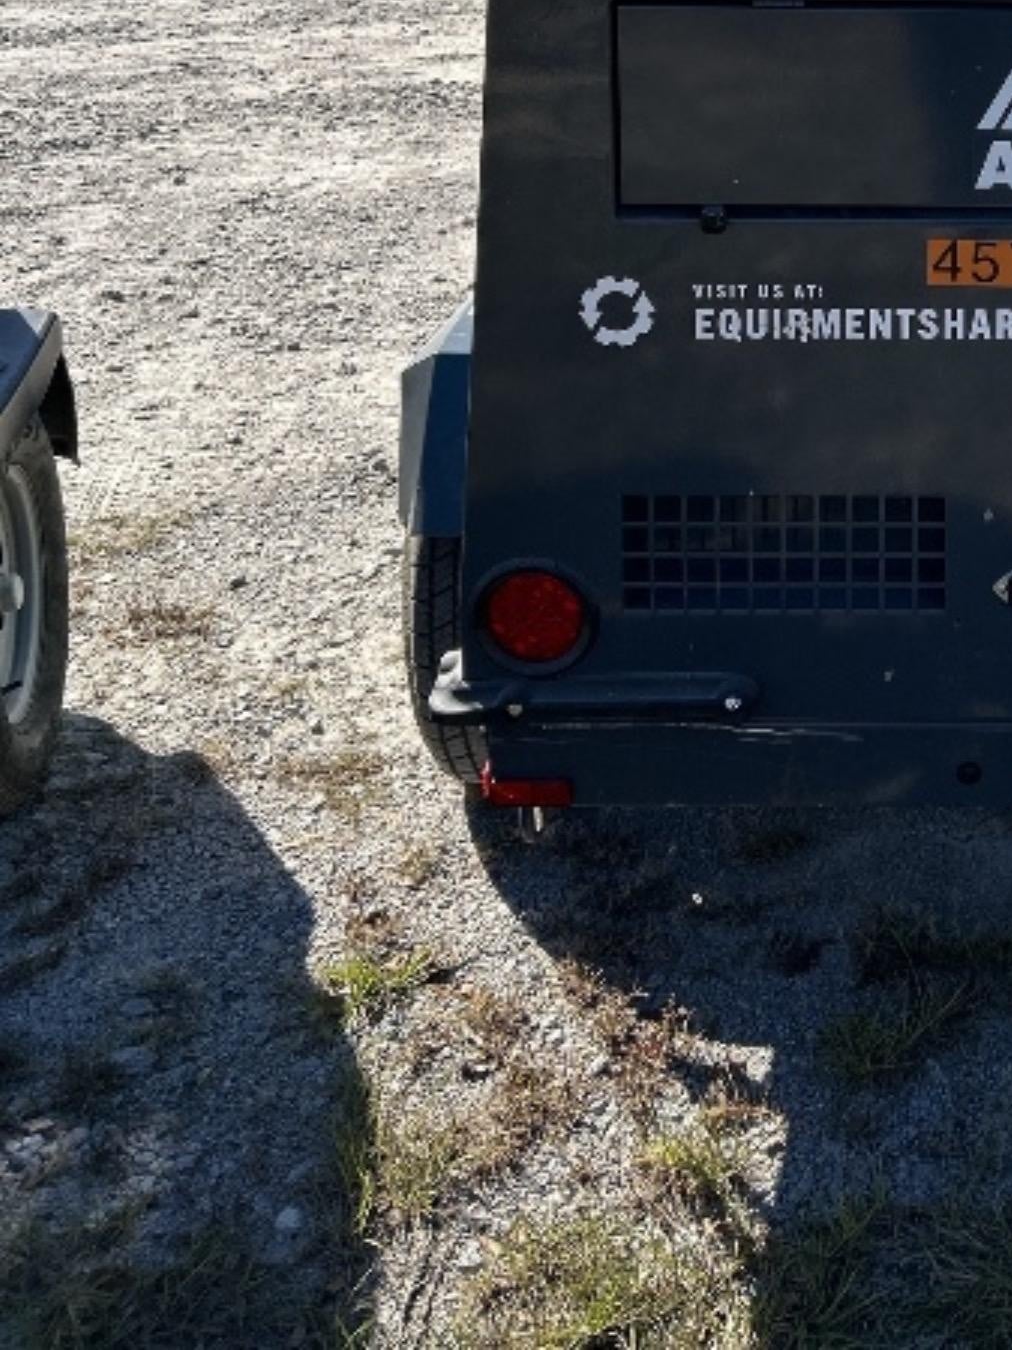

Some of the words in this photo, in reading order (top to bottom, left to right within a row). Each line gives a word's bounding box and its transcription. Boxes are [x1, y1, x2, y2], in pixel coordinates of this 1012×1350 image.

[692, 284, 748, 299] VISIT
[757, 284, 784, 299] US
[793, 284, 824, 299] AT:
